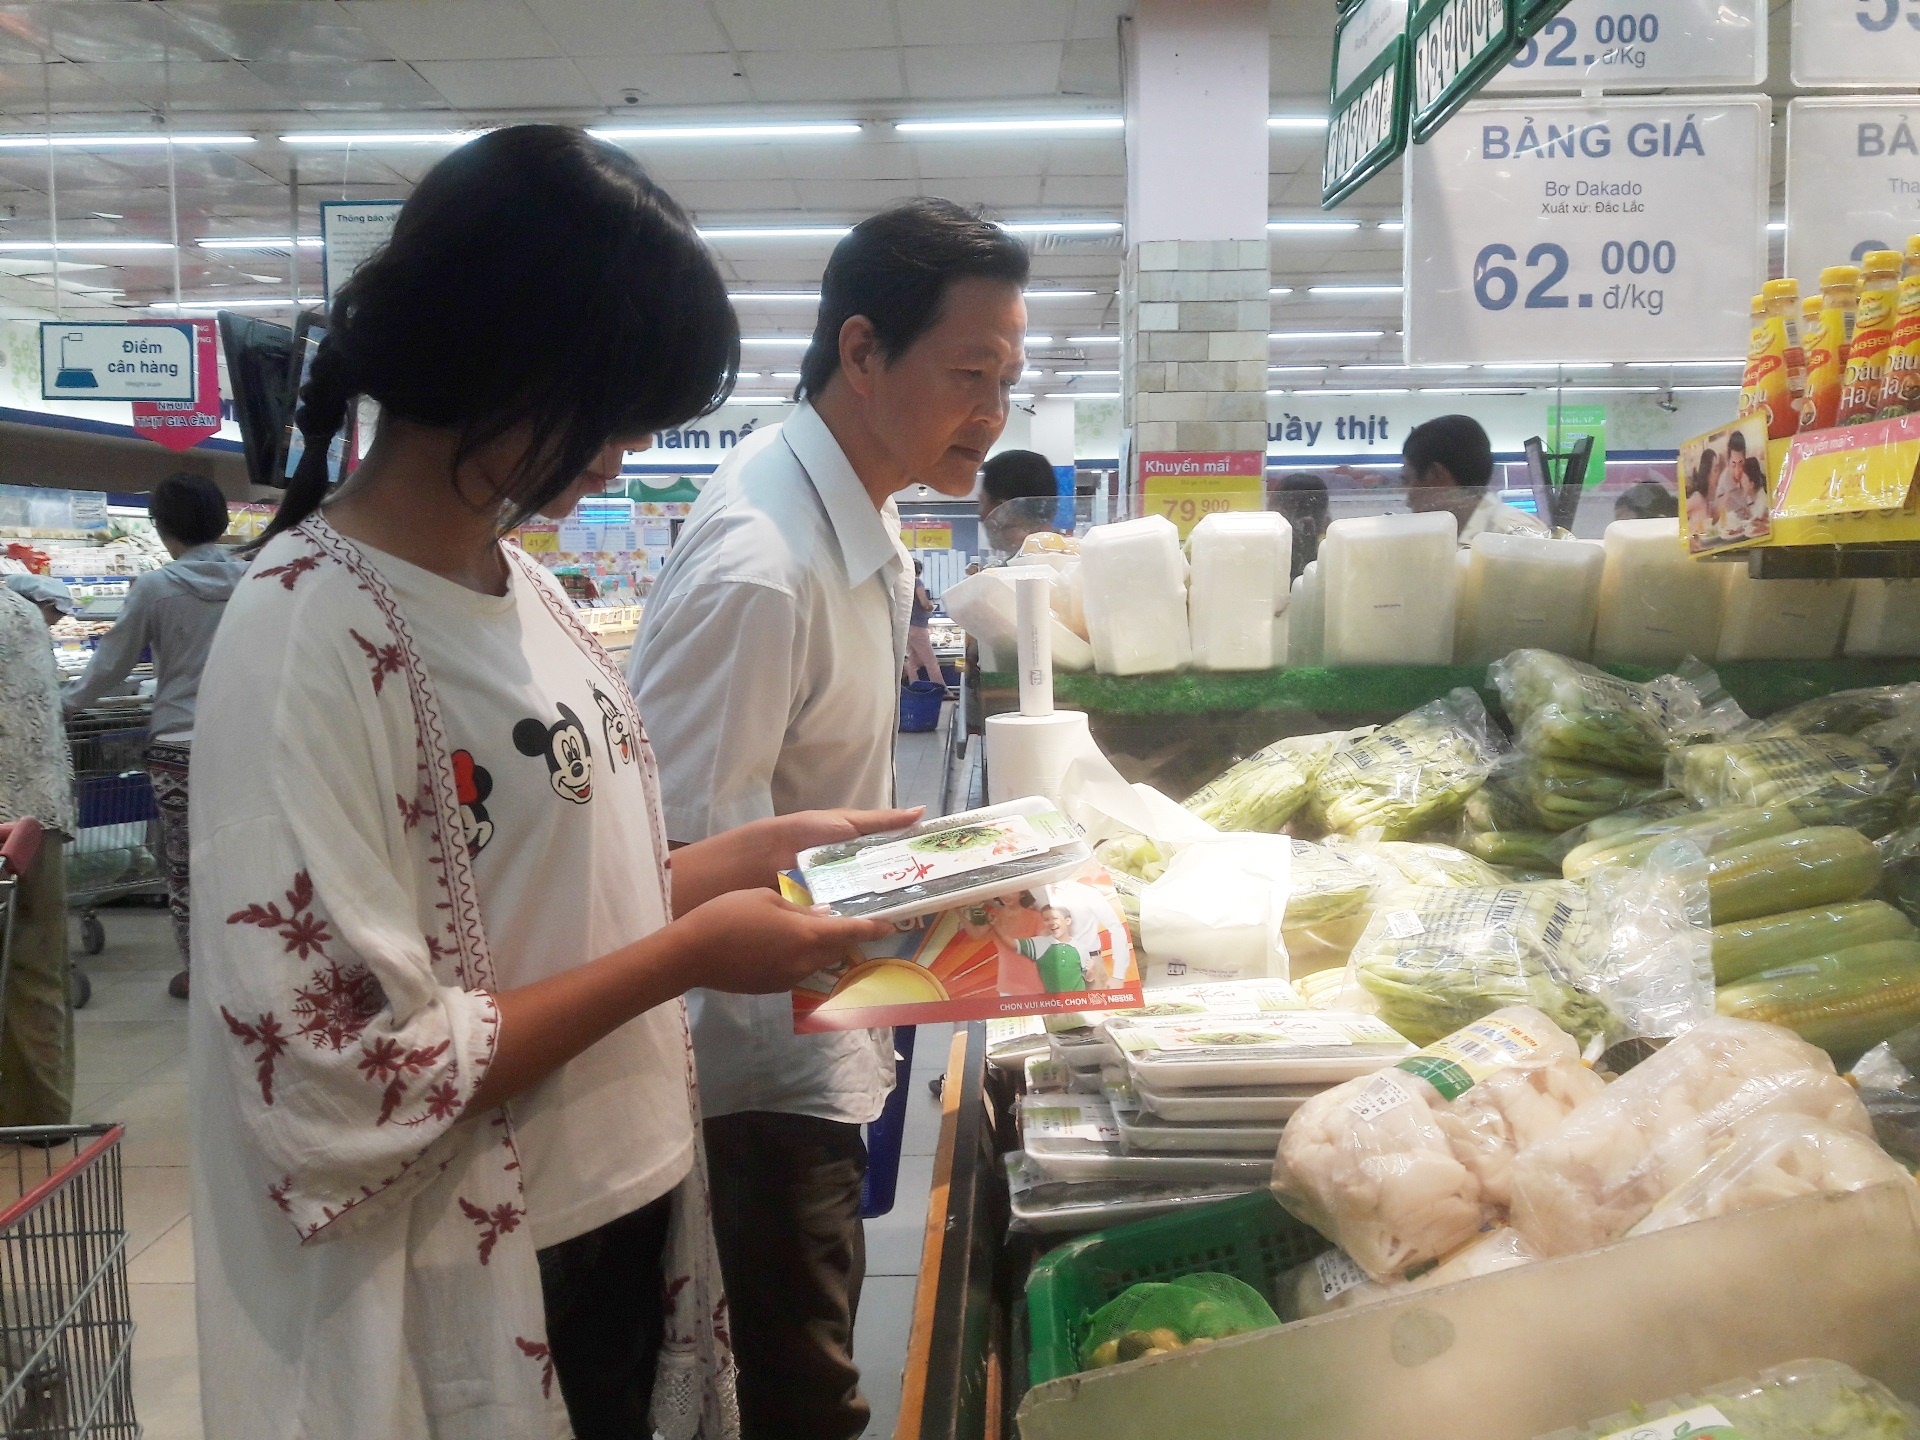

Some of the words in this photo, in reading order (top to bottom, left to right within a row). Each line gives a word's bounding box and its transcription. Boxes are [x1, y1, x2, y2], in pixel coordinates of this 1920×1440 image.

[1595, 13, 1659, 43] 000
[1482, 117, 1611, 160] BẢNG
[1627, 115, 1704, 157] GIÁ
[1545, 180, 1570, 196] Bơ
[1576, 179, 1642, 196] Dakado
[1542, 201, 1569, 213] Xuất
[1601, 240, 1676, 274] 000
[1473, 243, 1593, 311] 62.
[1603, 285, 1664, 315] đ/kg
[122, 337, 162, 353] Điểm
[107, 360, 135, 373] cân
[140, 360, 178, 377] hàng
[166, 416, 187, 427] GIA
[1335, 415, 1389, 445] thịt
[1145, 458, 1200, 475] Khuyến
[1201, 499, 1230, 513] 900
[1024, 1001, 1039, 1010] VUI
[1065, 997, 1088, 1006] CHỌN
